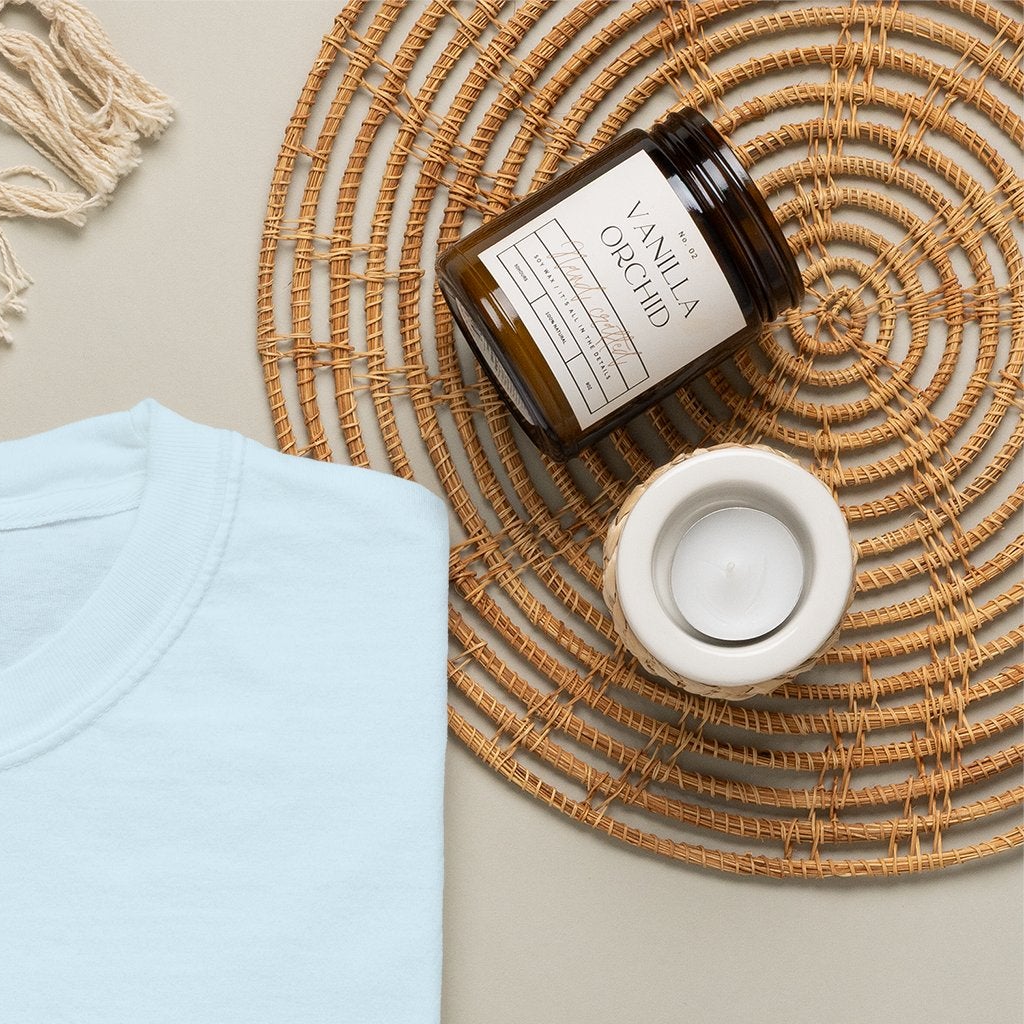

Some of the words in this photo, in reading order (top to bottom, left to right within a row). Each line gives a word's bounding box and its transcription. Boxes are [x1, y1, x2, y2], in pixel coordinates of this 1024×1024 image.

[600, 225, 671, 328] ORCHID
[626, 200, 700, 318] VANILLA
[688, 247, 699, 260] 02
[534, 254, 544, 267] SOY
[543, 269, 555, 283] WAX
[569, 309, 579, 323] ALL
[578, 324, 586, 334] IN
[585, 335, 595, 350] THE
[593, 351, 611, 380] DETAILS
[553, 323, 567, 344] NATURAL
